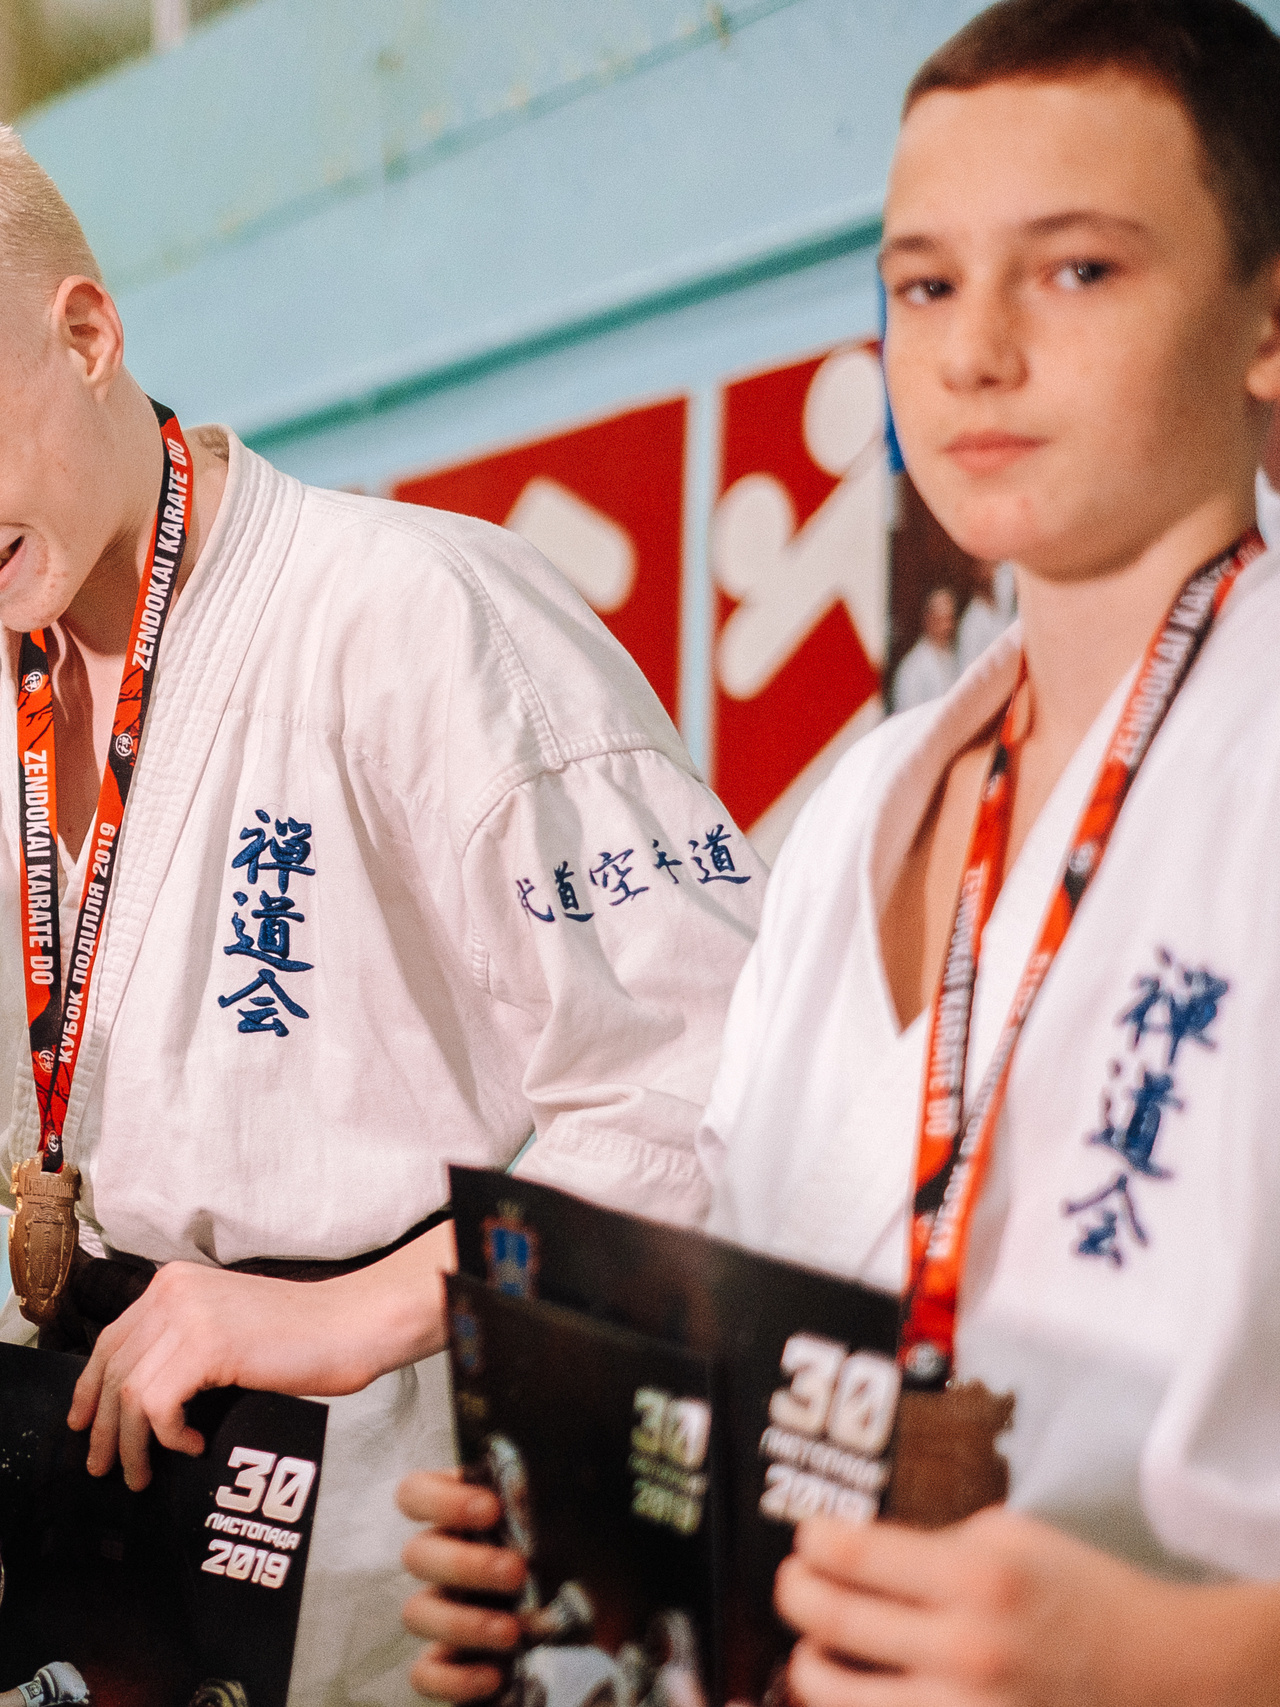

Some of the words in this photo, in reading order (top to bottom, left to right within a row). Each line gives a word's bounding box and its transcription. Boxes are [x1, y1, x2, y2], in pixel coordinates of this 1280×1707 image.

[166, 438, 186, 467] DO
[157, 466, 189, 556] KARATE
[132, 555, 176, 672] ZENDOKAI
[23, 750, 52, 859] ZENDOKAI
[27, 864, 53, 949] KARATE
[57, 990, 85, 1064] КУБОК
[72, 880, 105, 986] ПОДІЛЛЯ
[91, 822, 117, 879] 2019
[30, 955, 55, 986] DO
[769, 1333, 902, 1456] 30
[215, 1446, 317, 1523] 30
[201, 1538, 291, 1590] 2019
[204, 1512, 302, 1551] ЛИСТОПАДА
